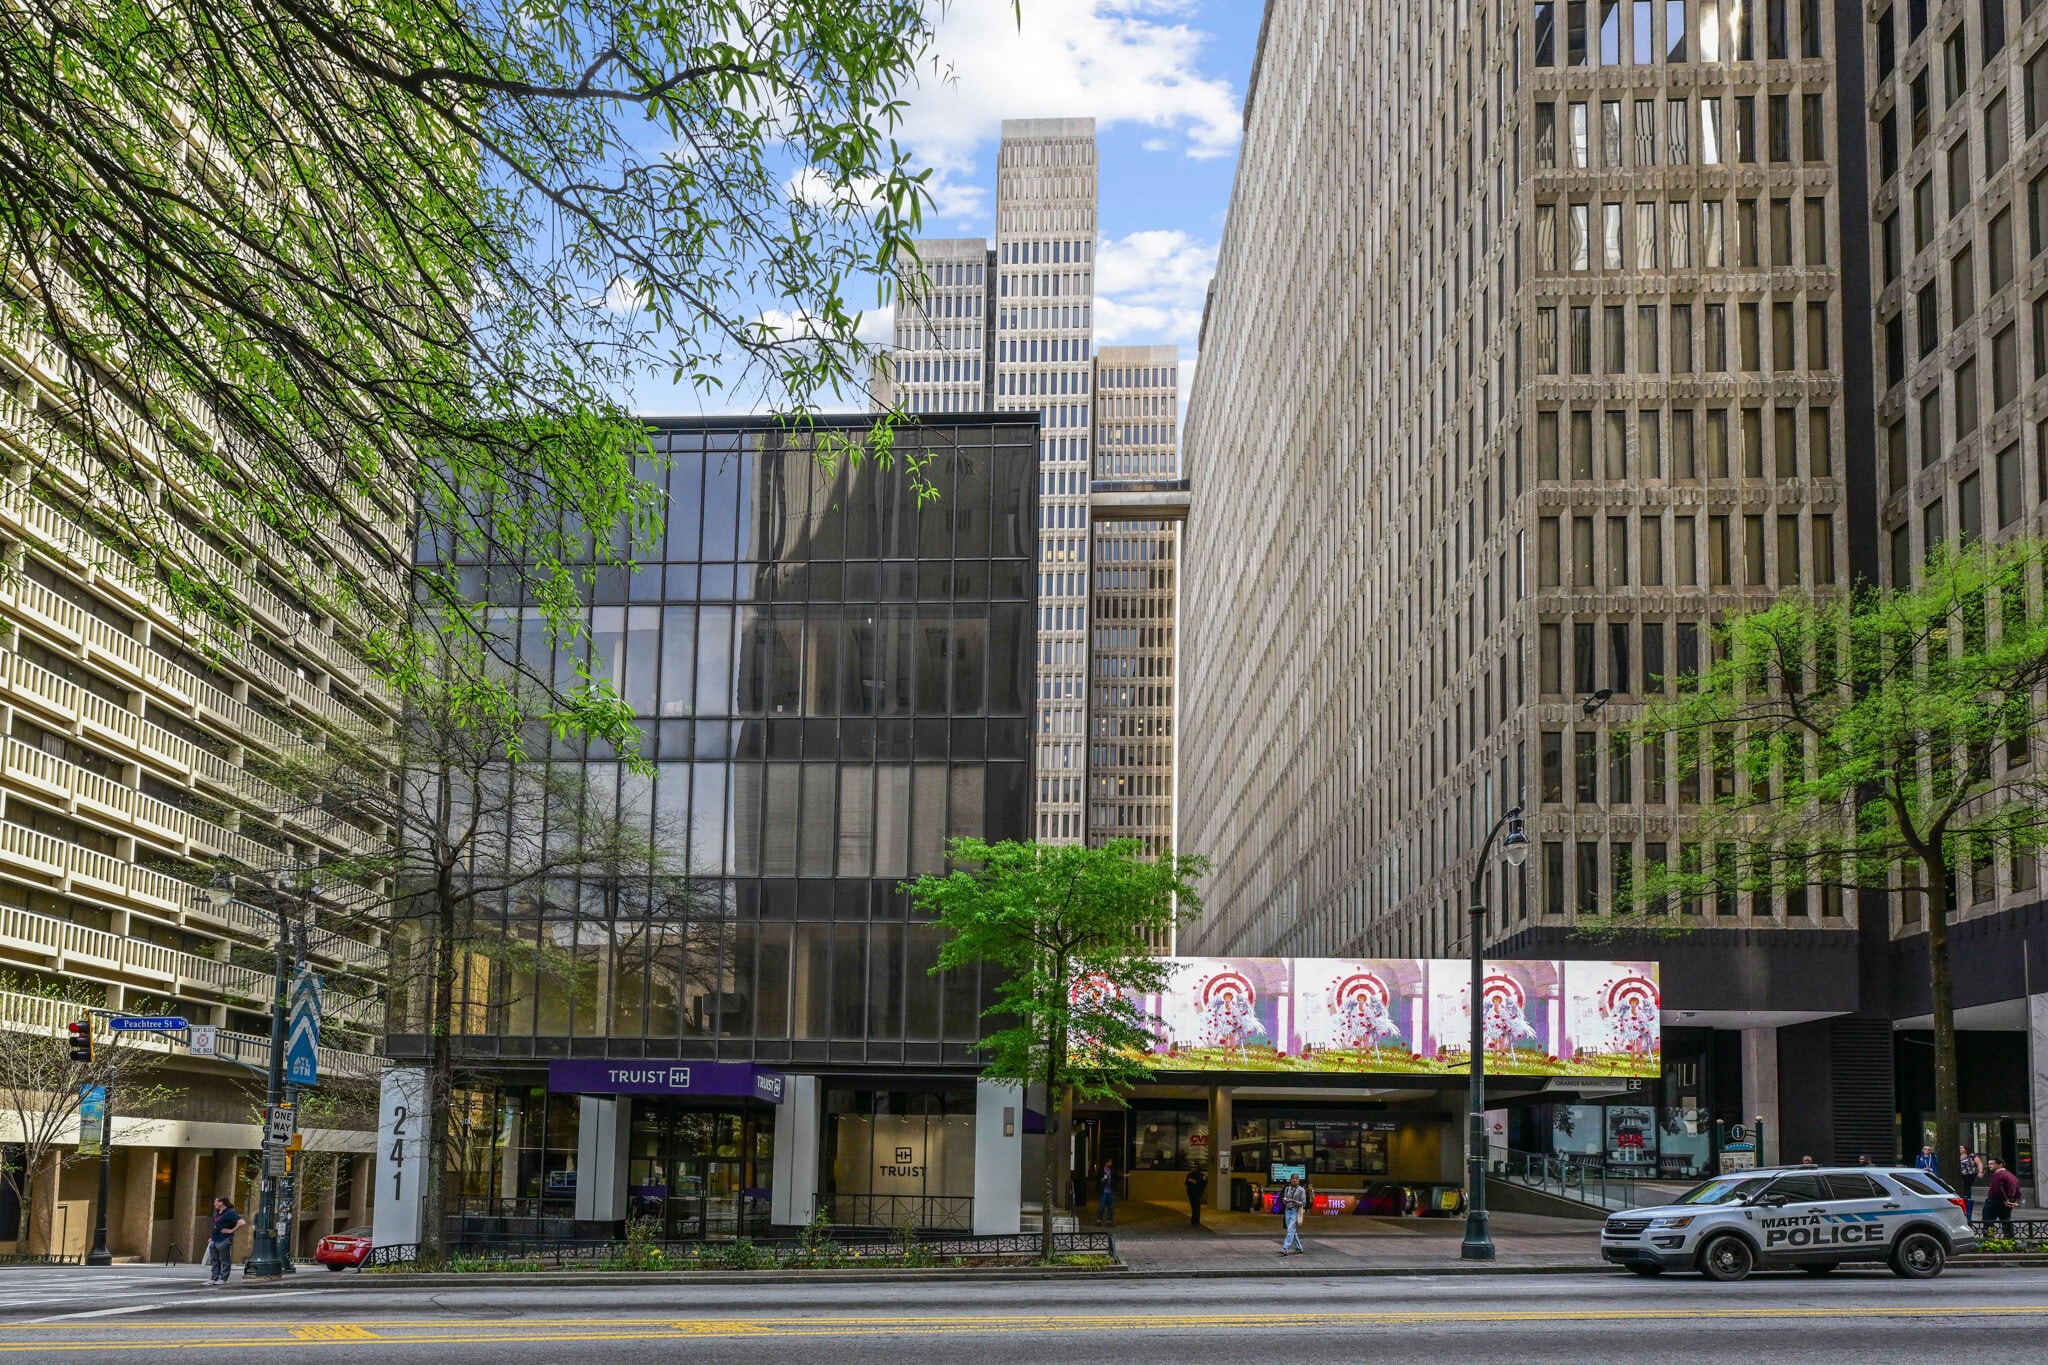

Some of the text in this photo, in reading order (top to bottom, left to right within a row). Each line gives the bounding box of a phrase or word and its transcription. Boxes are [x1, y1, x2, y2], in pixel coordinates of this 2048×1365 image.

[124, 1020, 162, 1028] Peachtree
[164, 1020, 173, 1028] St
[293, 1056, 311, 1068] ATL
[292, 1066, 311, 1077] DTN
[608, 1069, 667, 1083] TRUIST
[756, 1075, 775, 1092] TRUIST
[274, 1110, 292, 1121] ONE
[273, 1121, 291, 1132] WAY
[879, 1165, 928, 1177] TRUIST
[1327, 1199, 1346, 1209] THIS
[1761, 1215, 1821, 1229] MARTA
[1766, 1223, 1885, 1248] POLICE
